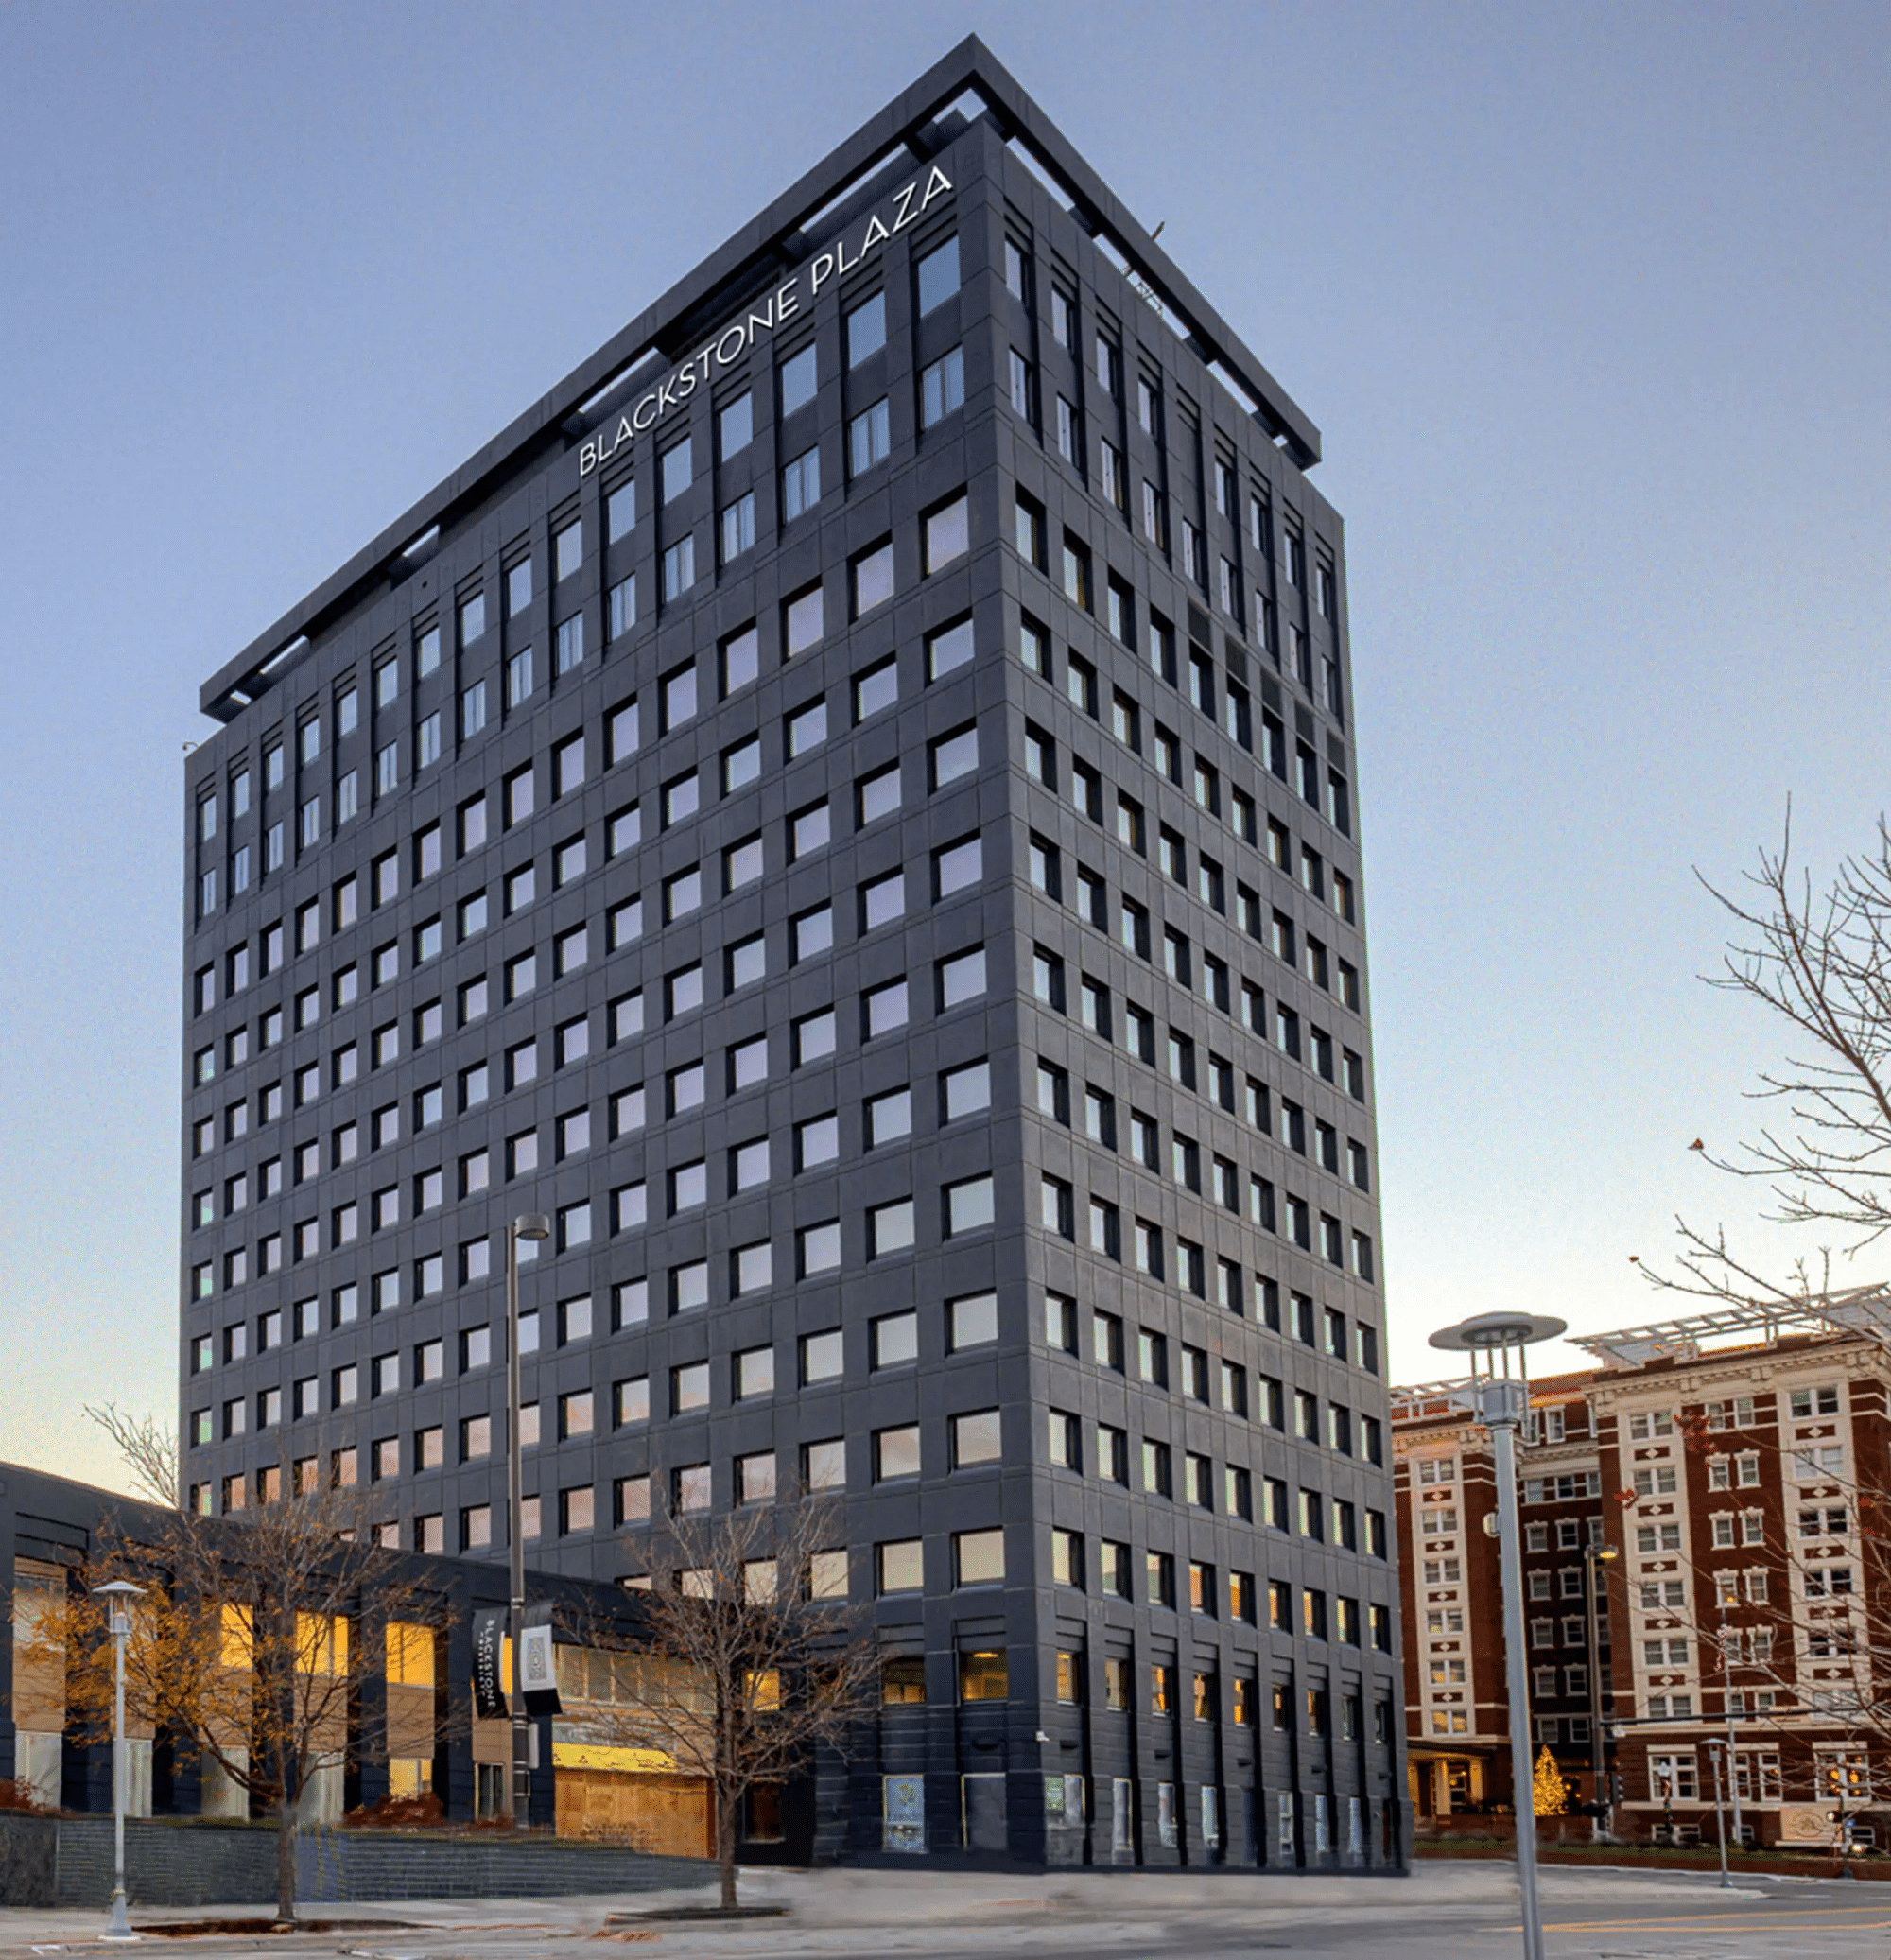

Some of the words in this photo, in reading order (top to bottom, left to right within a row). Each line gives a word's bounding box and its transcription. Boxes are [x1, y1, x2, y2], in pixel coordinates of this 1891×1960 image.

[579, 278, 800, 477] BLACKSTONE
[812, 165, 953, 295] PLAZA
[483, 1619, 496, 1708] BLACKSTONE
